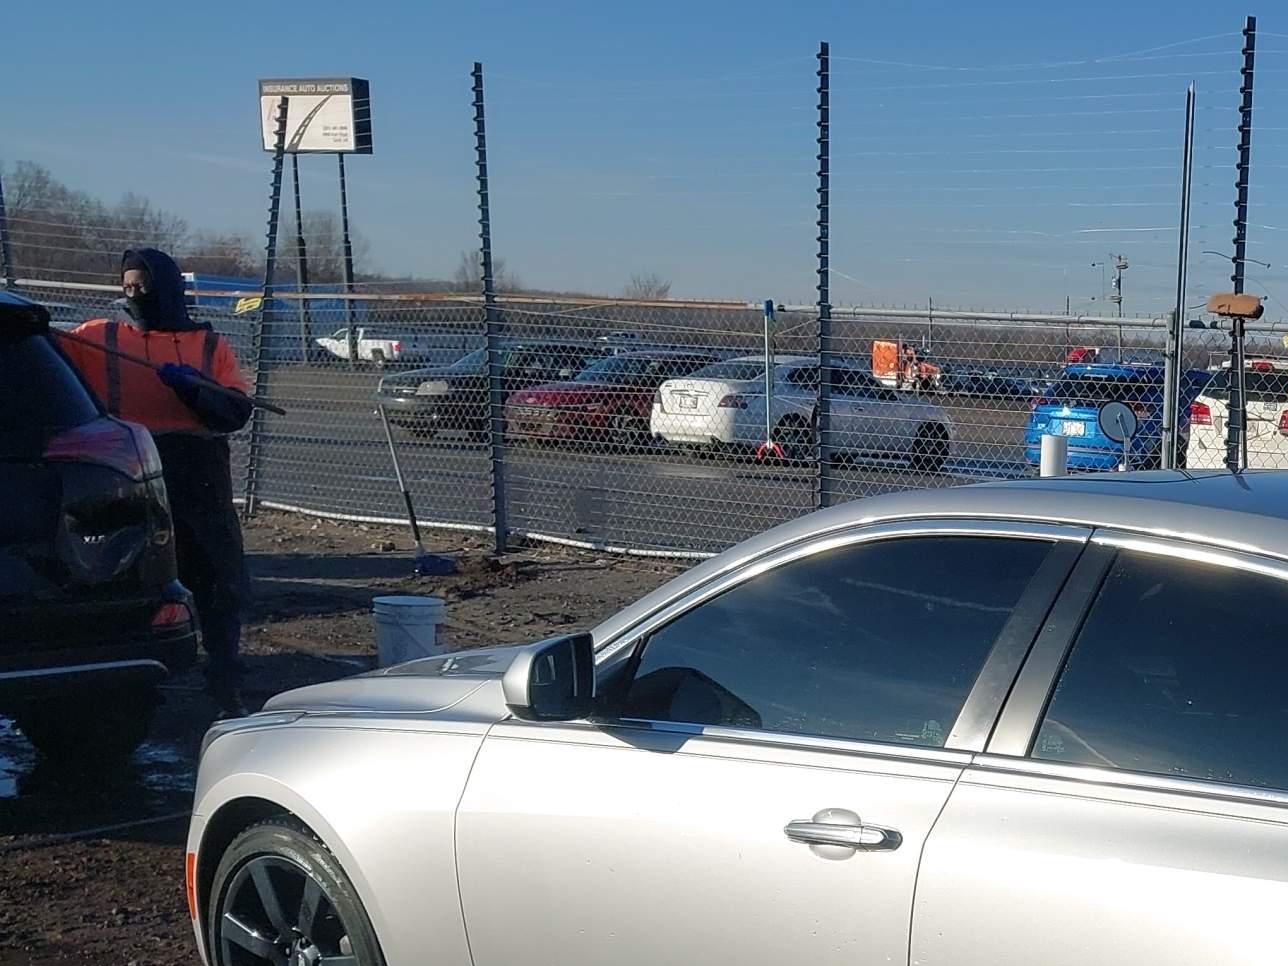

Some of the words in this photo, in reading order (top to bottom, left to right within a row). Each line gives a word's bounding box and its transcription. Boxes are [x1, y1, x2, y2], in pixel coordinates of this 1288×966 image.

[262, 85, 298, 93] INSURANCE
[298, 84, 316, 92] AUTO
[316, 84, 349, 92] AUCTIONS
